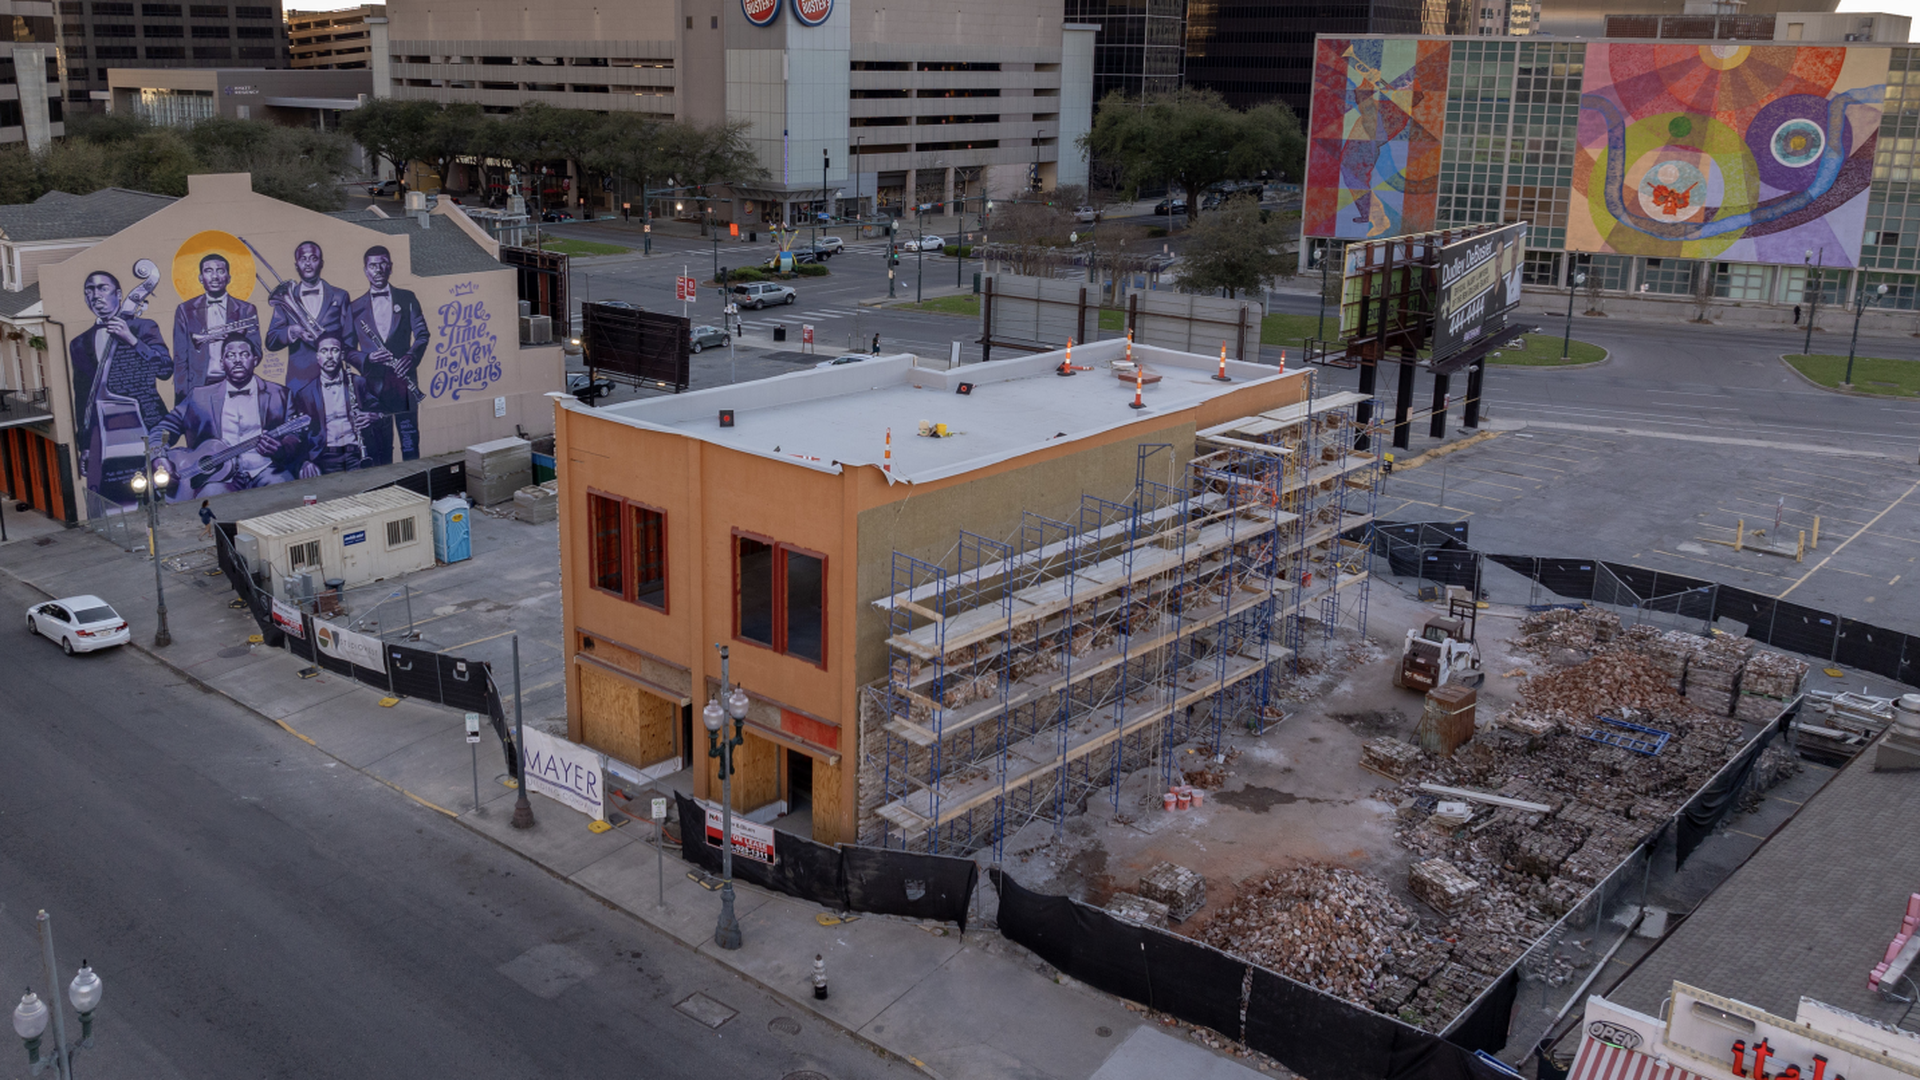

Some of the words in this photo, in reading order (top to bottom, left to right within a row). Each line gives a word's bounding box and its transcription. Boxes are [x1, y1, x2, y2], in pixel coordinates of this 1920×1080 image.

[1442, 257, 1465, 284] Dudley
[438, 300, 491, 328] One
[1449, 295, 1485, 337] 444-4444
[435, 322, 491, 354] Time,
[435, 355, 448, 370] in
[448, 335, 497, 374] New
[430, 361, 502, 400] Orleans
[524, 747, 598, 799] MAYER
[526, 777, 560, 797] UILDING
[744, 838, 767, 850] LEASE
[1590, 1022, 1638, 1049] OPEN
[1731, 1036, 1845, 1080] ital
